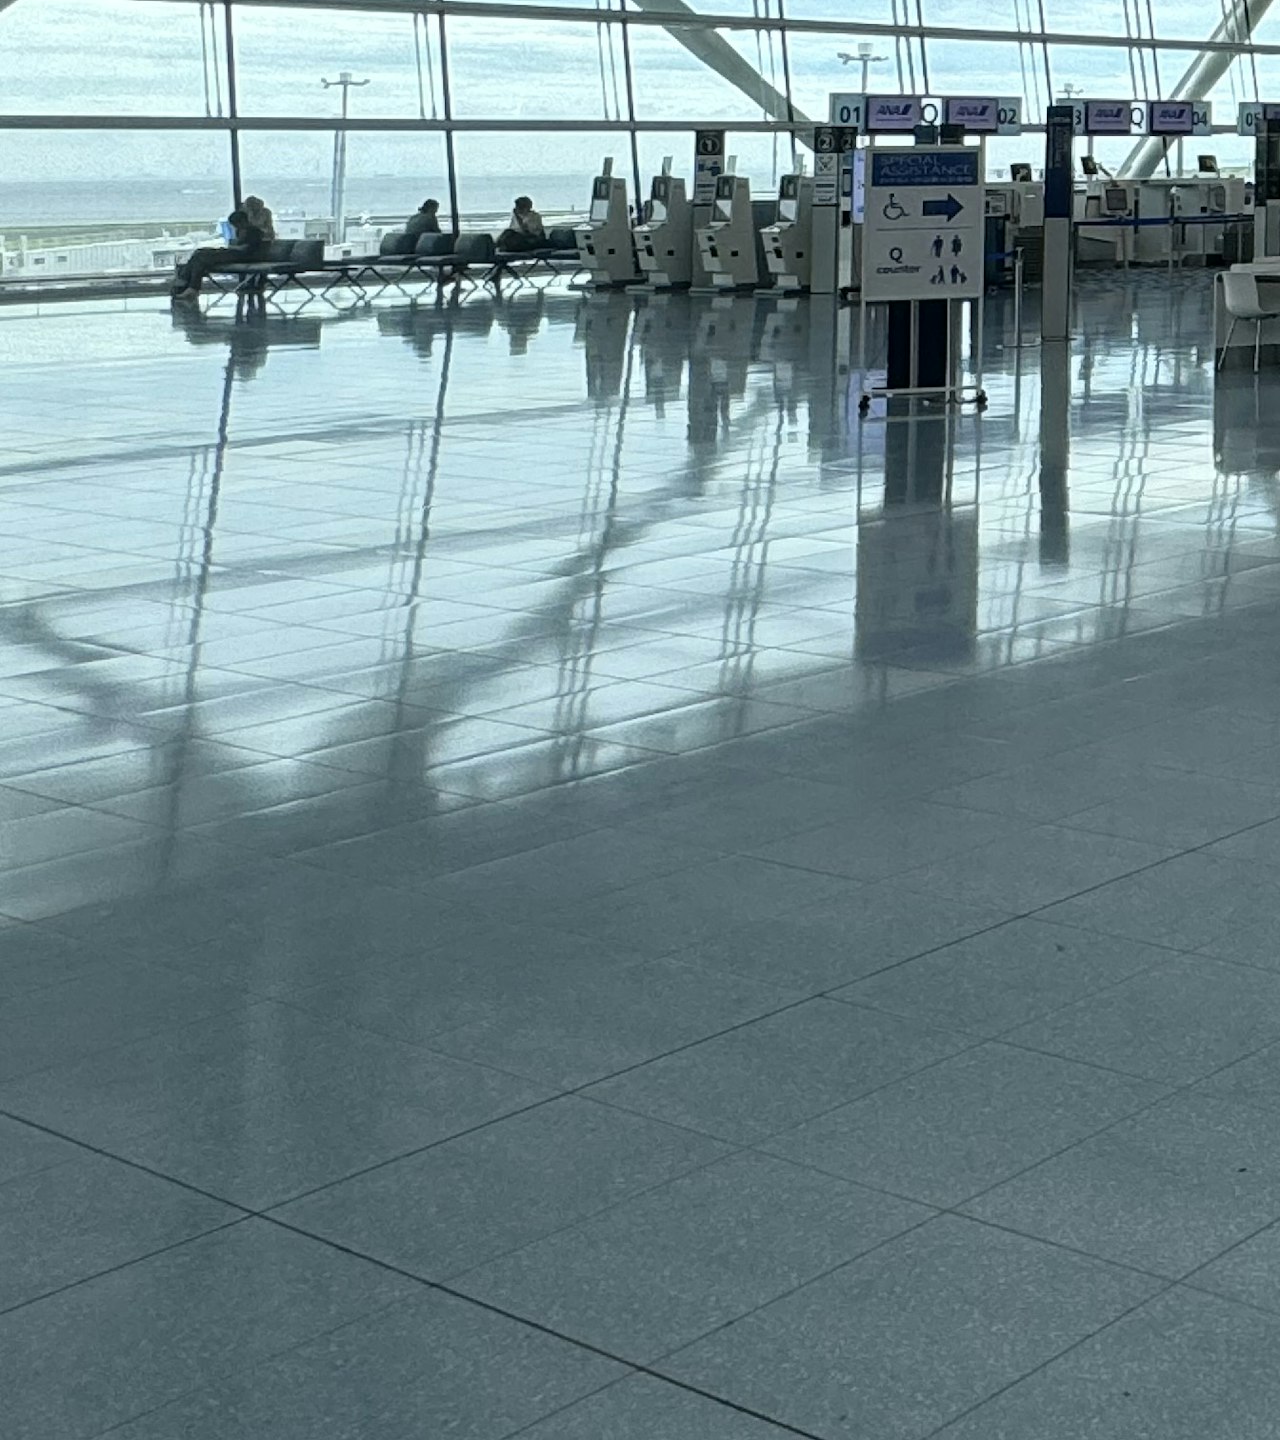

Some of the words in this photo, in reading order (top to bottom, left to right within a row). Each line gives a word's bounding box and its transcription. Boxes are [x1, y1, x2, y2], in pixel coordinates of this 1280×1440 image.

[840, 106, 860, 123] 01
[999, 108, 1017, 124] 02
[1074, 109, 1082, 126] 3
[1192, 111, 1208, 126] 04
[880, 156, 941, 167] SPECIAL
[880, 164, 970, 177] ASSISTANCE
[889, 247, 903, 264] Q
